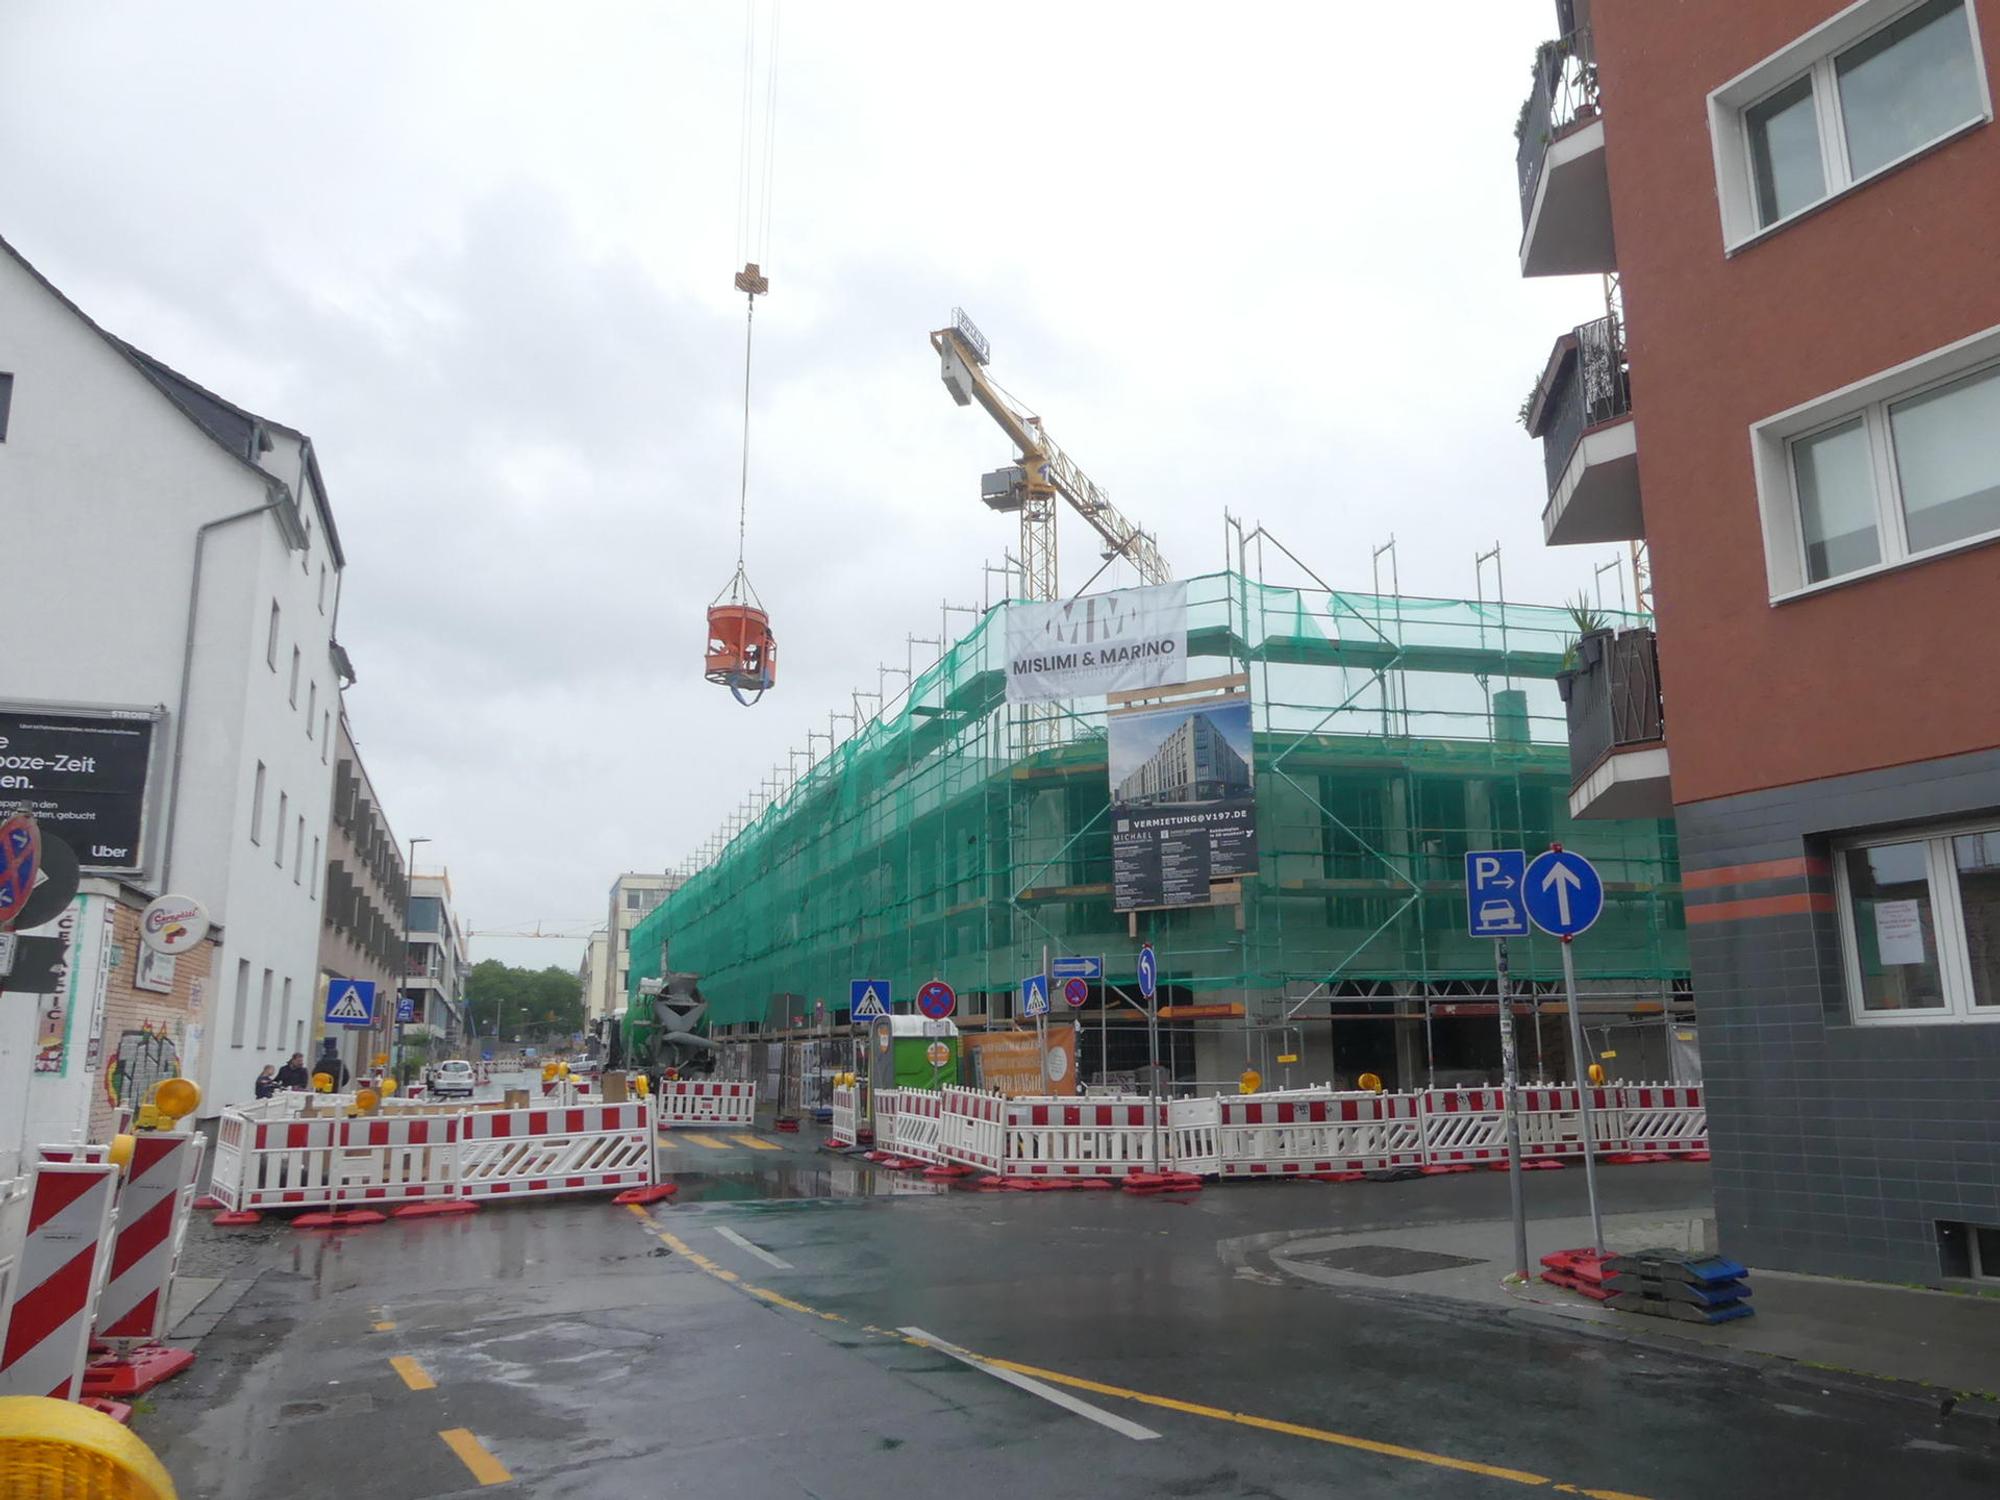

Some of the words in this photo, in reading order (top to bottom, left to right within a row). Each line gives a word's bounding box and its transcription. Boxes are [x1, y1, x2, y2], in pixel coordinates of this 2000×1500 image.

[1013, 653, 1077, 675] MISLIMI
[1082, 651, 1095, 666] &
[1101, 640, 1175, 664] MARINO
[39, 800, 58, 809] den
[56, 812, 96, 820] gebucht
[1134, 810, 1247, 828] VERMIETUNG@V197.DE
[1113, 832, 1152, 842] MICHAEL
[92, 845, 128, 858] Uber
[1475, 857, 1500, 890] P
